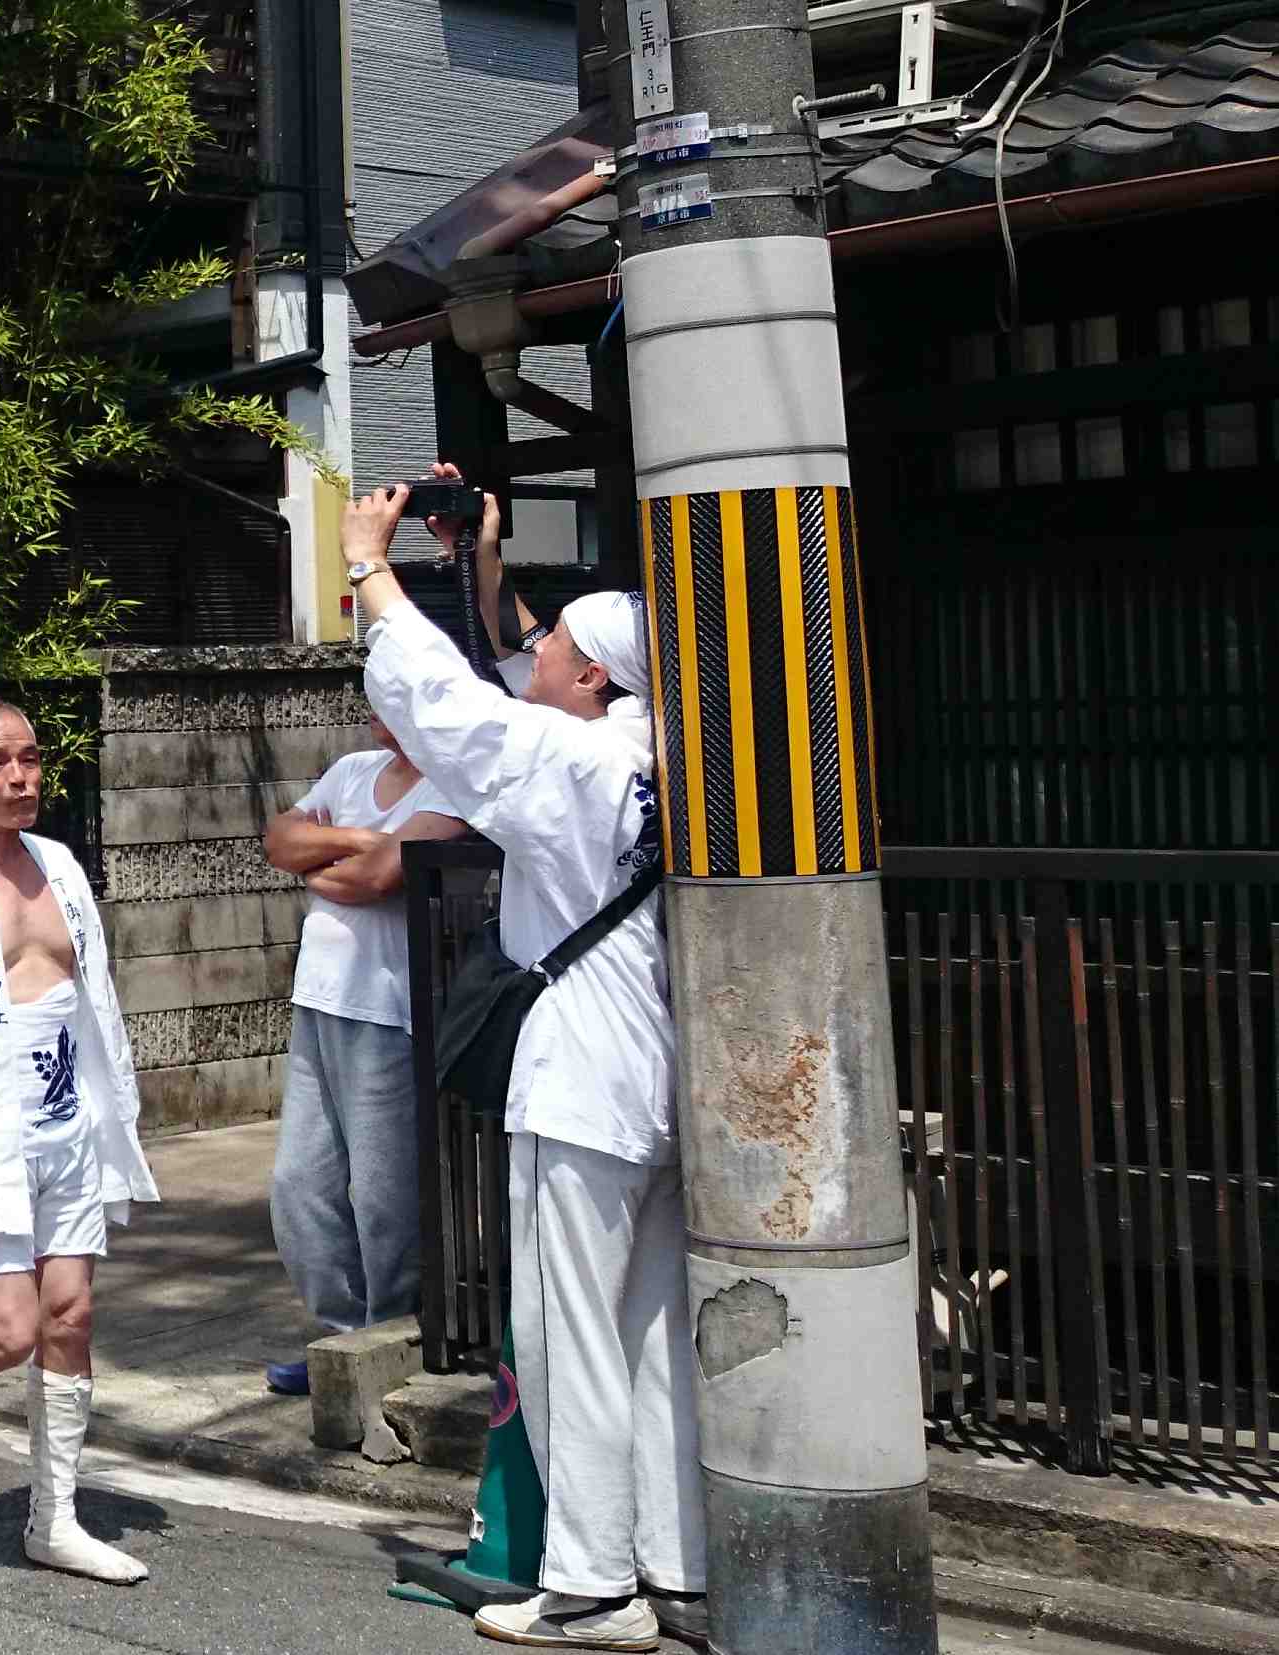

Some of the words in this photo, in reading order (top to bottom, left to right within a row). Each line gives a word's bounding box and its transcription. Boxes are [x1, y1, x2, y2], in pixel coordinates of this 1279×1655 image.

[639, 9, 656, 58] 仁王門
[647, 69, 653, 80] 3
